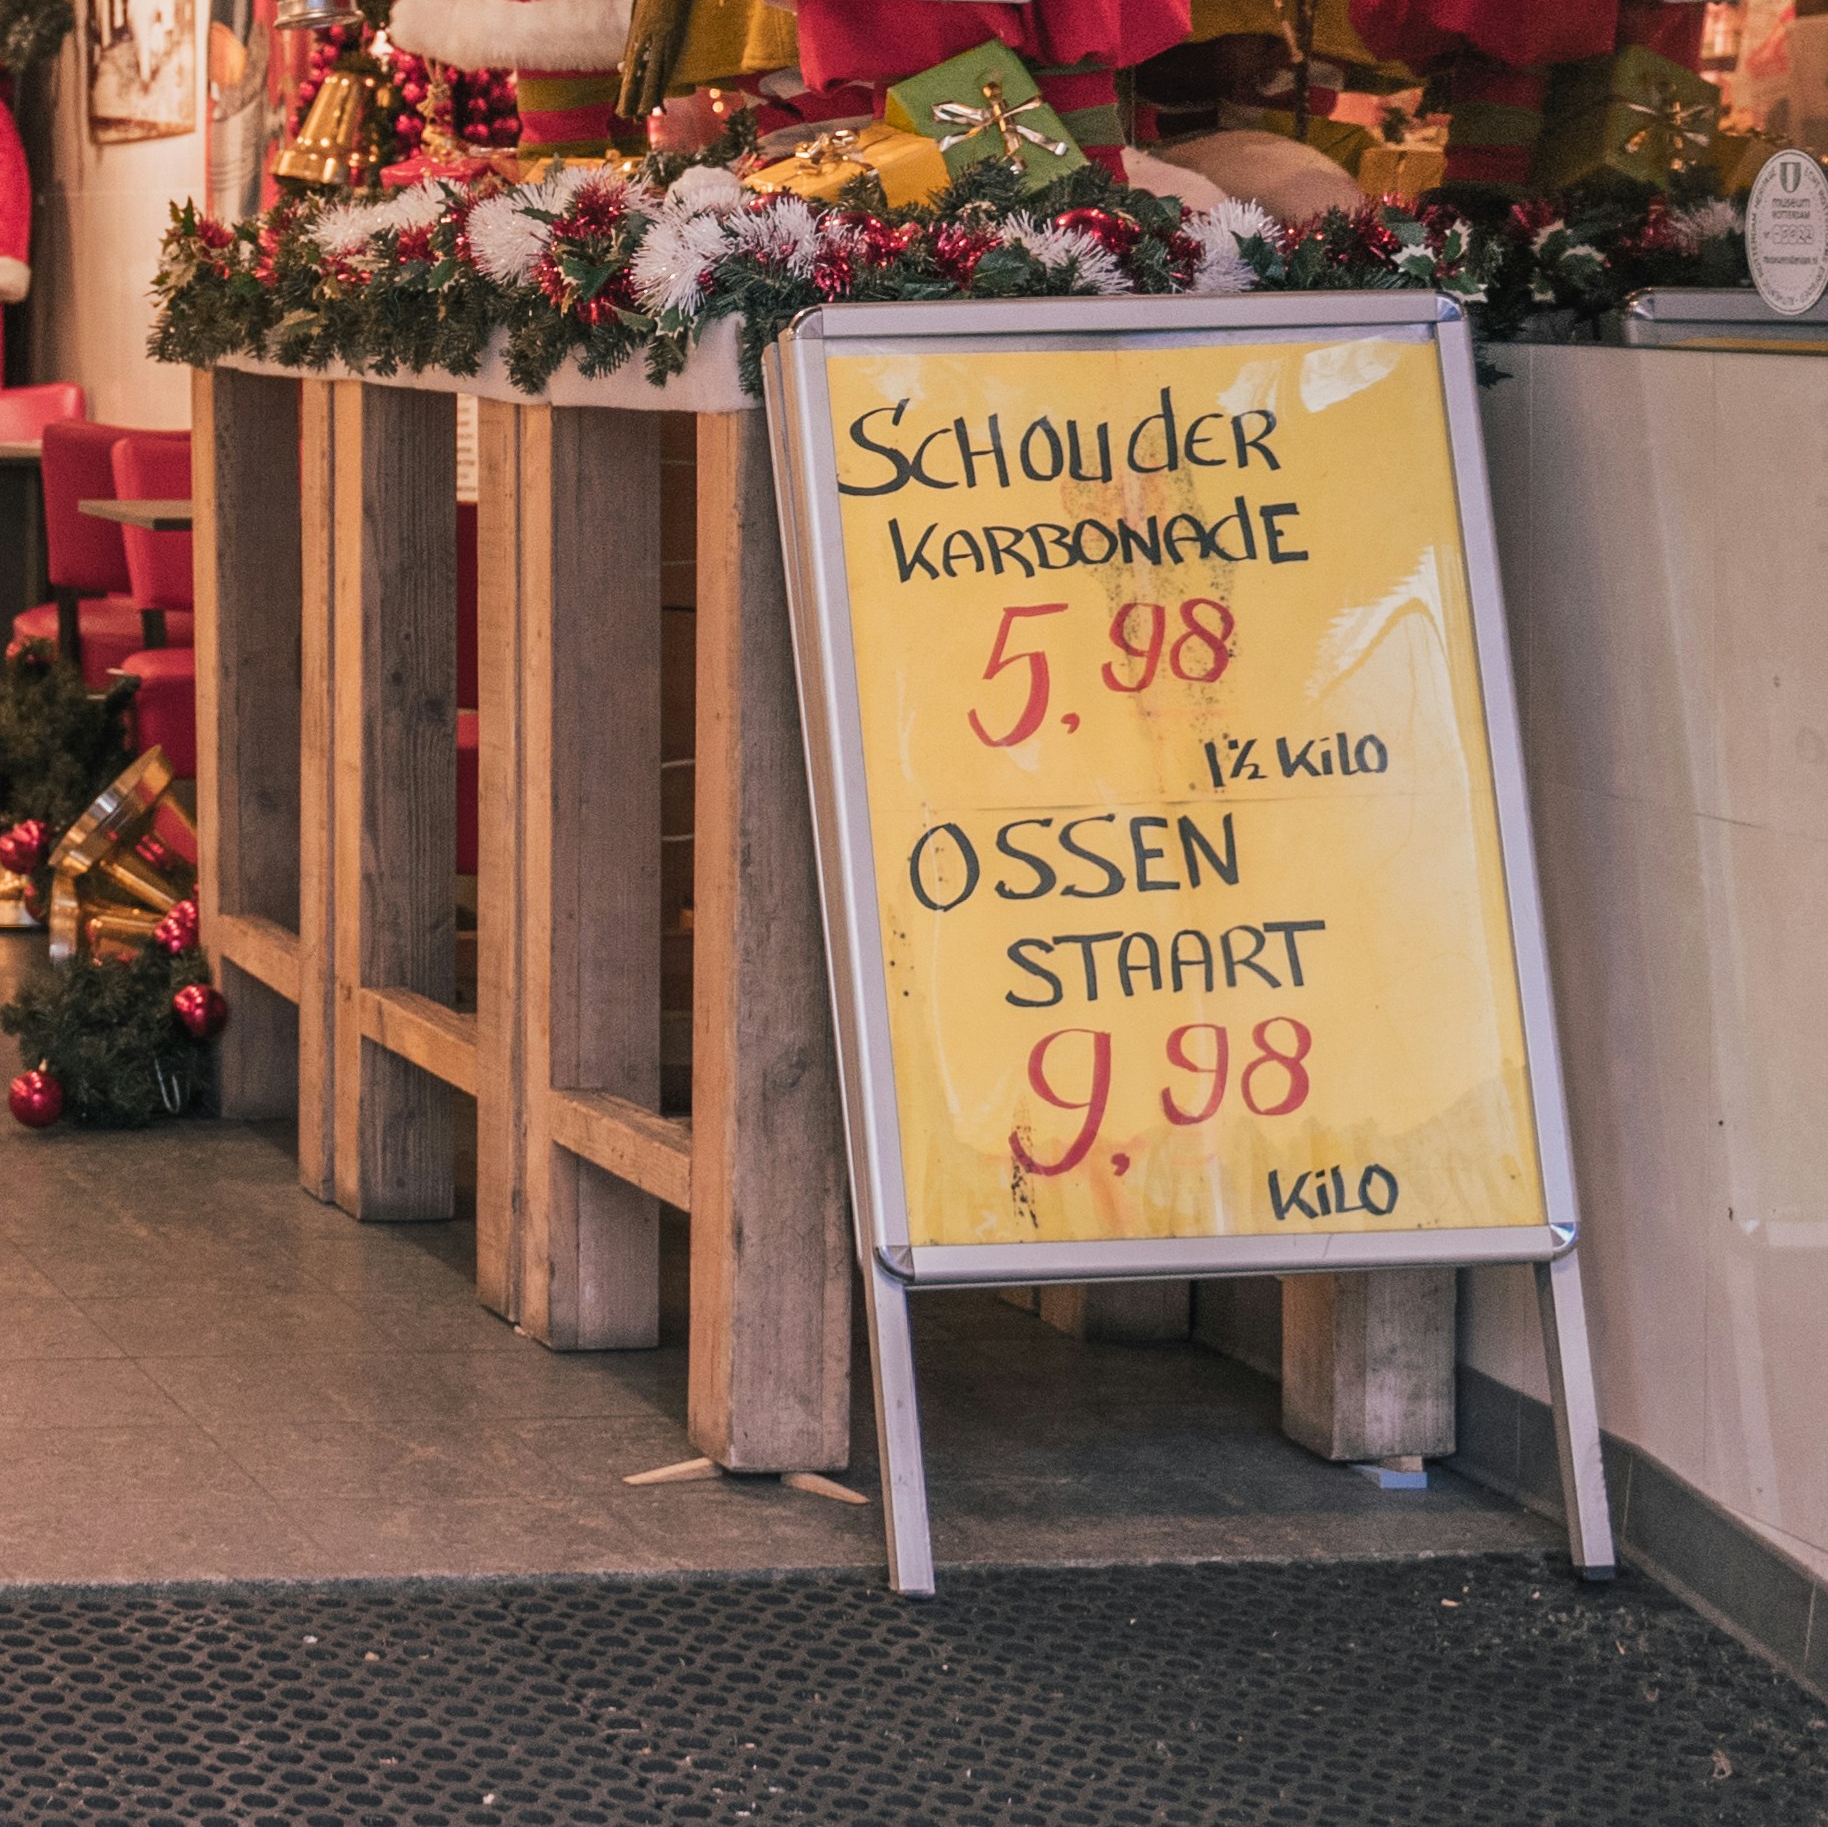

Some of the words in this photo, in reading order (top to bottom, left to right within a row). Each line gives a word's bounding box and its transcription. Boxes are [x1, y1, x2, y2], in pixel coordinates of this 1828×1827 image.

[1772, 198, 1811, 208] museum
[967, 597, 1235, 748] 5,98
[909, 812, 1240, 912] OSSEN
[1004, 919, 1326, 1009] STAART
[1008, 1016, 1312, 1177] 9,98
